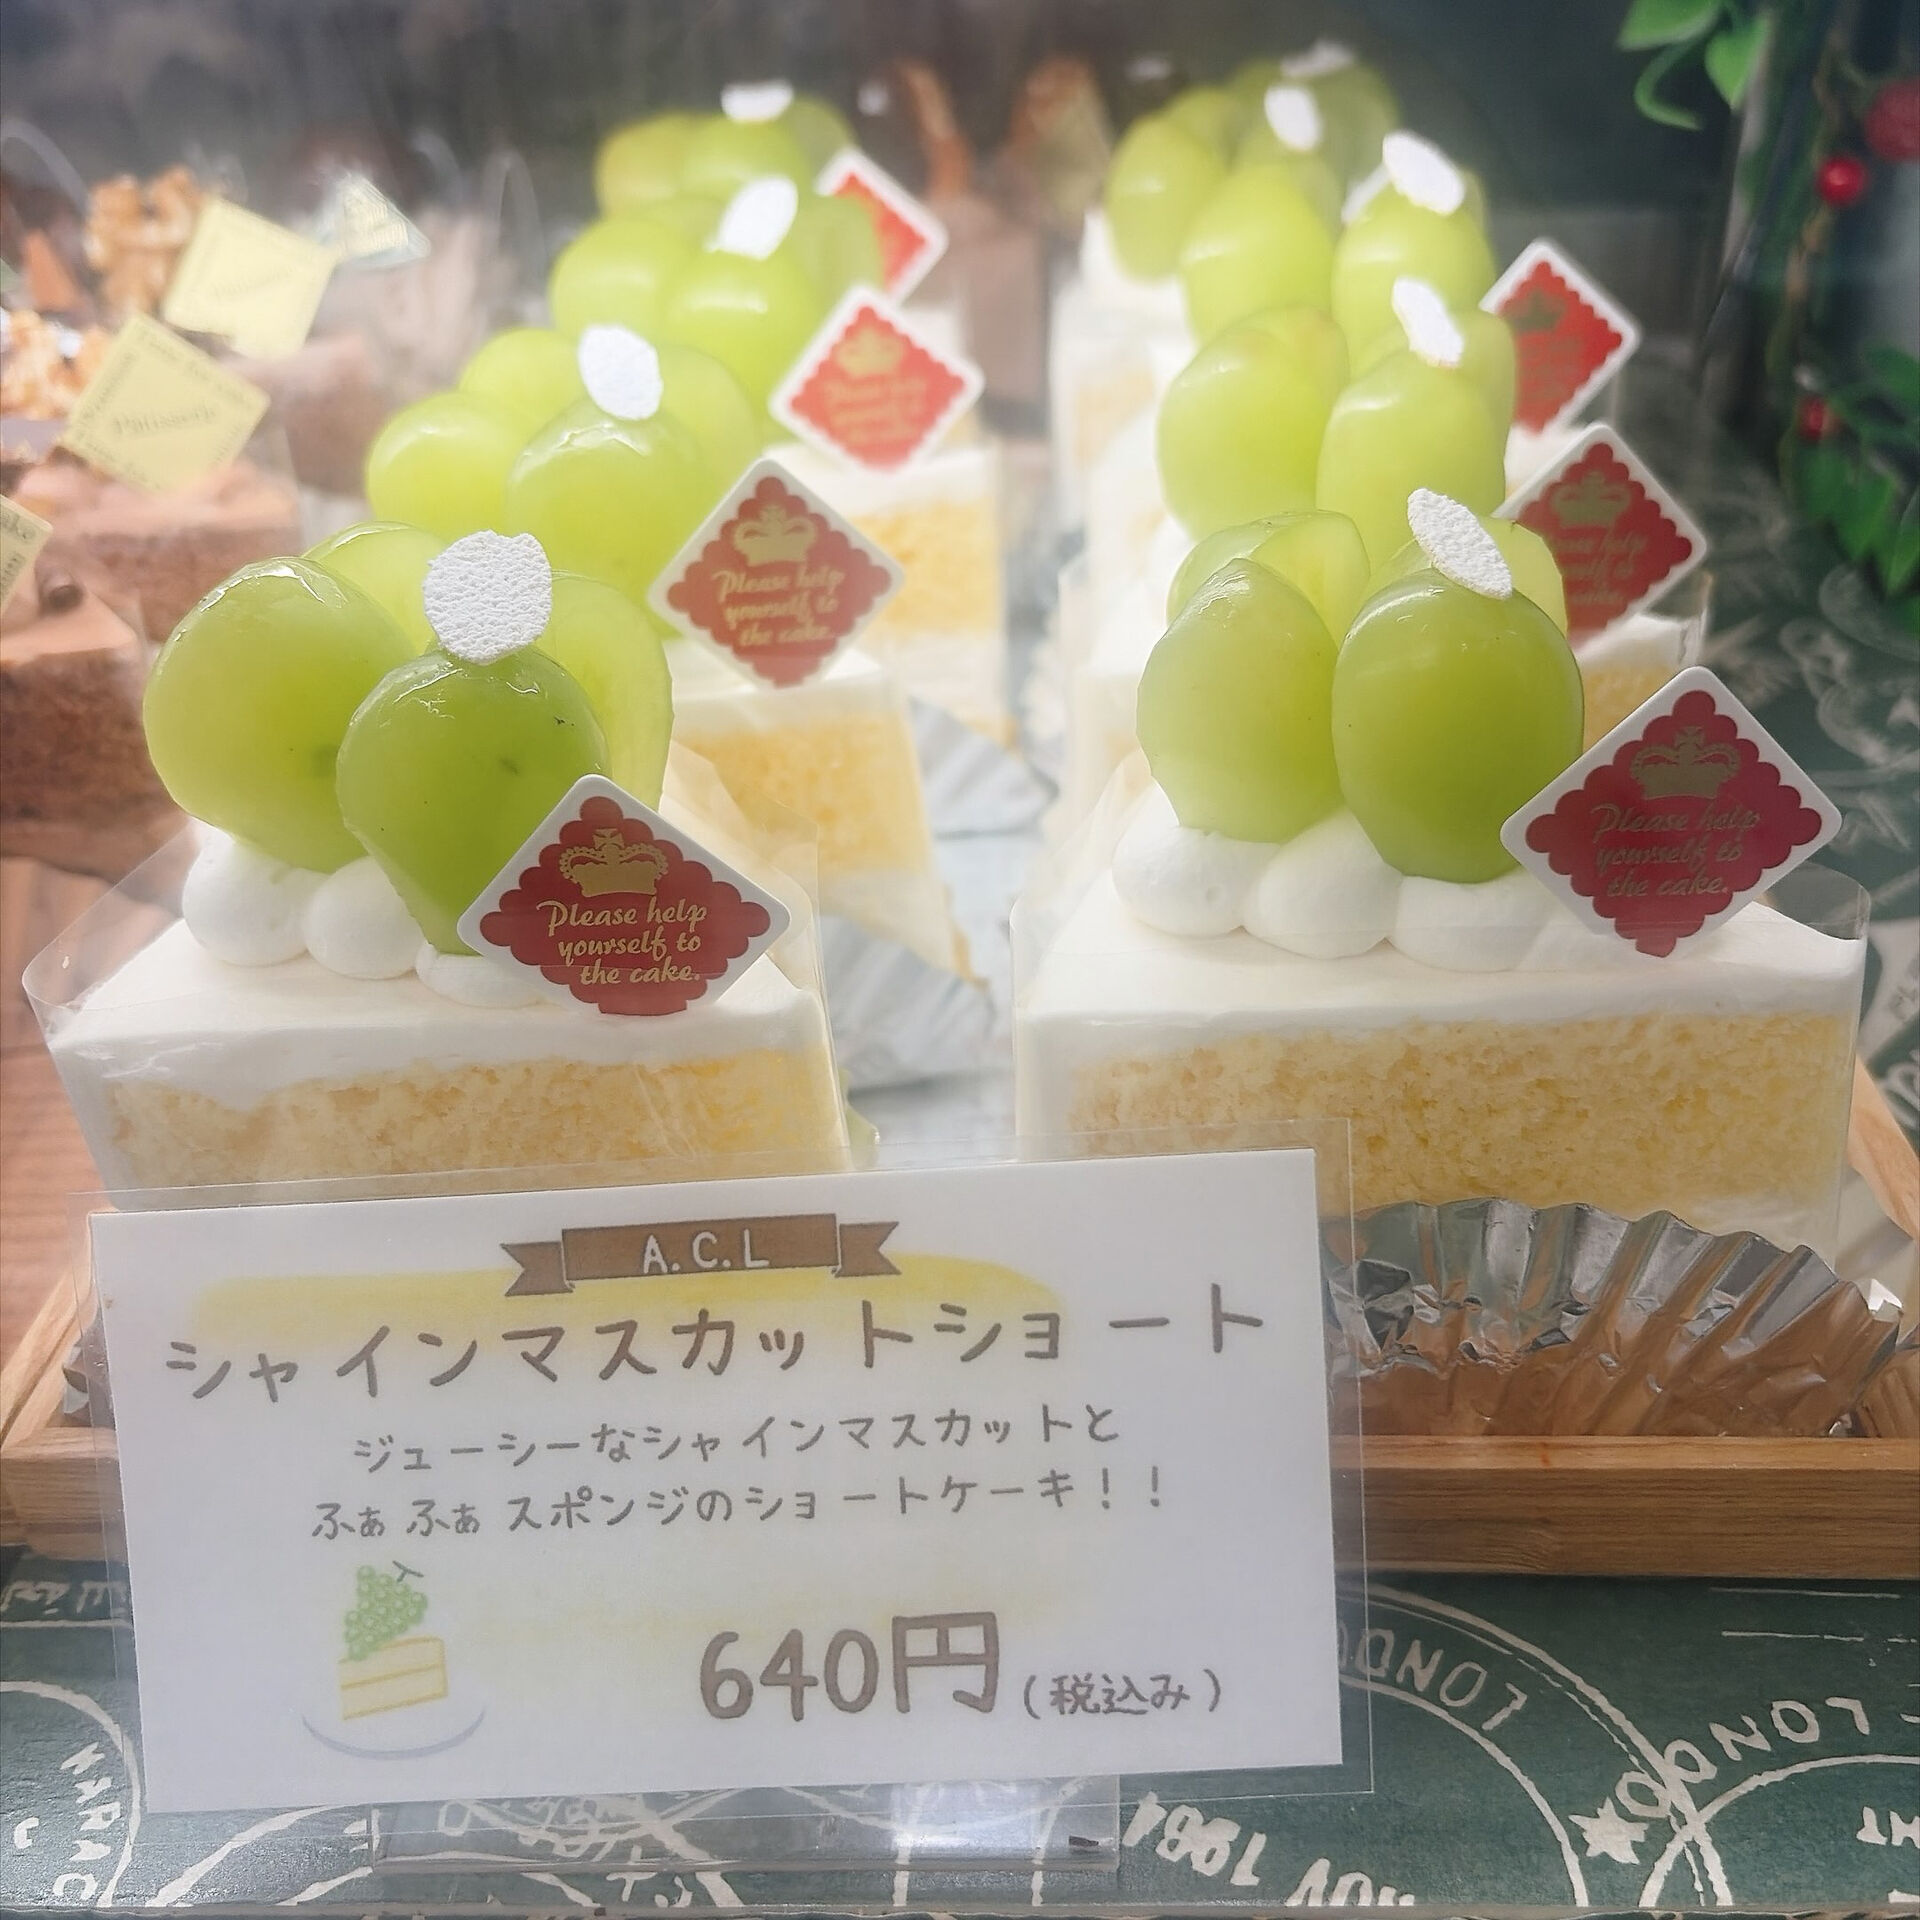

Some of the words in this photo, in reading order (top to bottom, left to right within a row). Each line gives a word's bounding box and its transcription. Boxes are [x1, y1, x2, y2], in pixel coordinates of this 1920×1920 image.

[1591, 803, 1689, 843] Please
[1697, 802, 1761, 839] help
[1596, 836, 1709, 877] yourself
[1716, 839, 1742, 862] to
[1606, 868, 1647, 897] the
[1656, 871, 1729, 896] cake.
[536, 900, 638, 937] Please
[647, 896, 707, 932] help
[558, 923, 668, 967] yourself
[676, 932, 701, 952] to
[580, 959, 621, 985] the
[629, 955, 701, 983] cake.
[642, 1229, 769, 1272] A.C.L
[165, 1283, 1263, 1402] シャインマスカットショート
[700, 1611, 998, 1722] 640円
